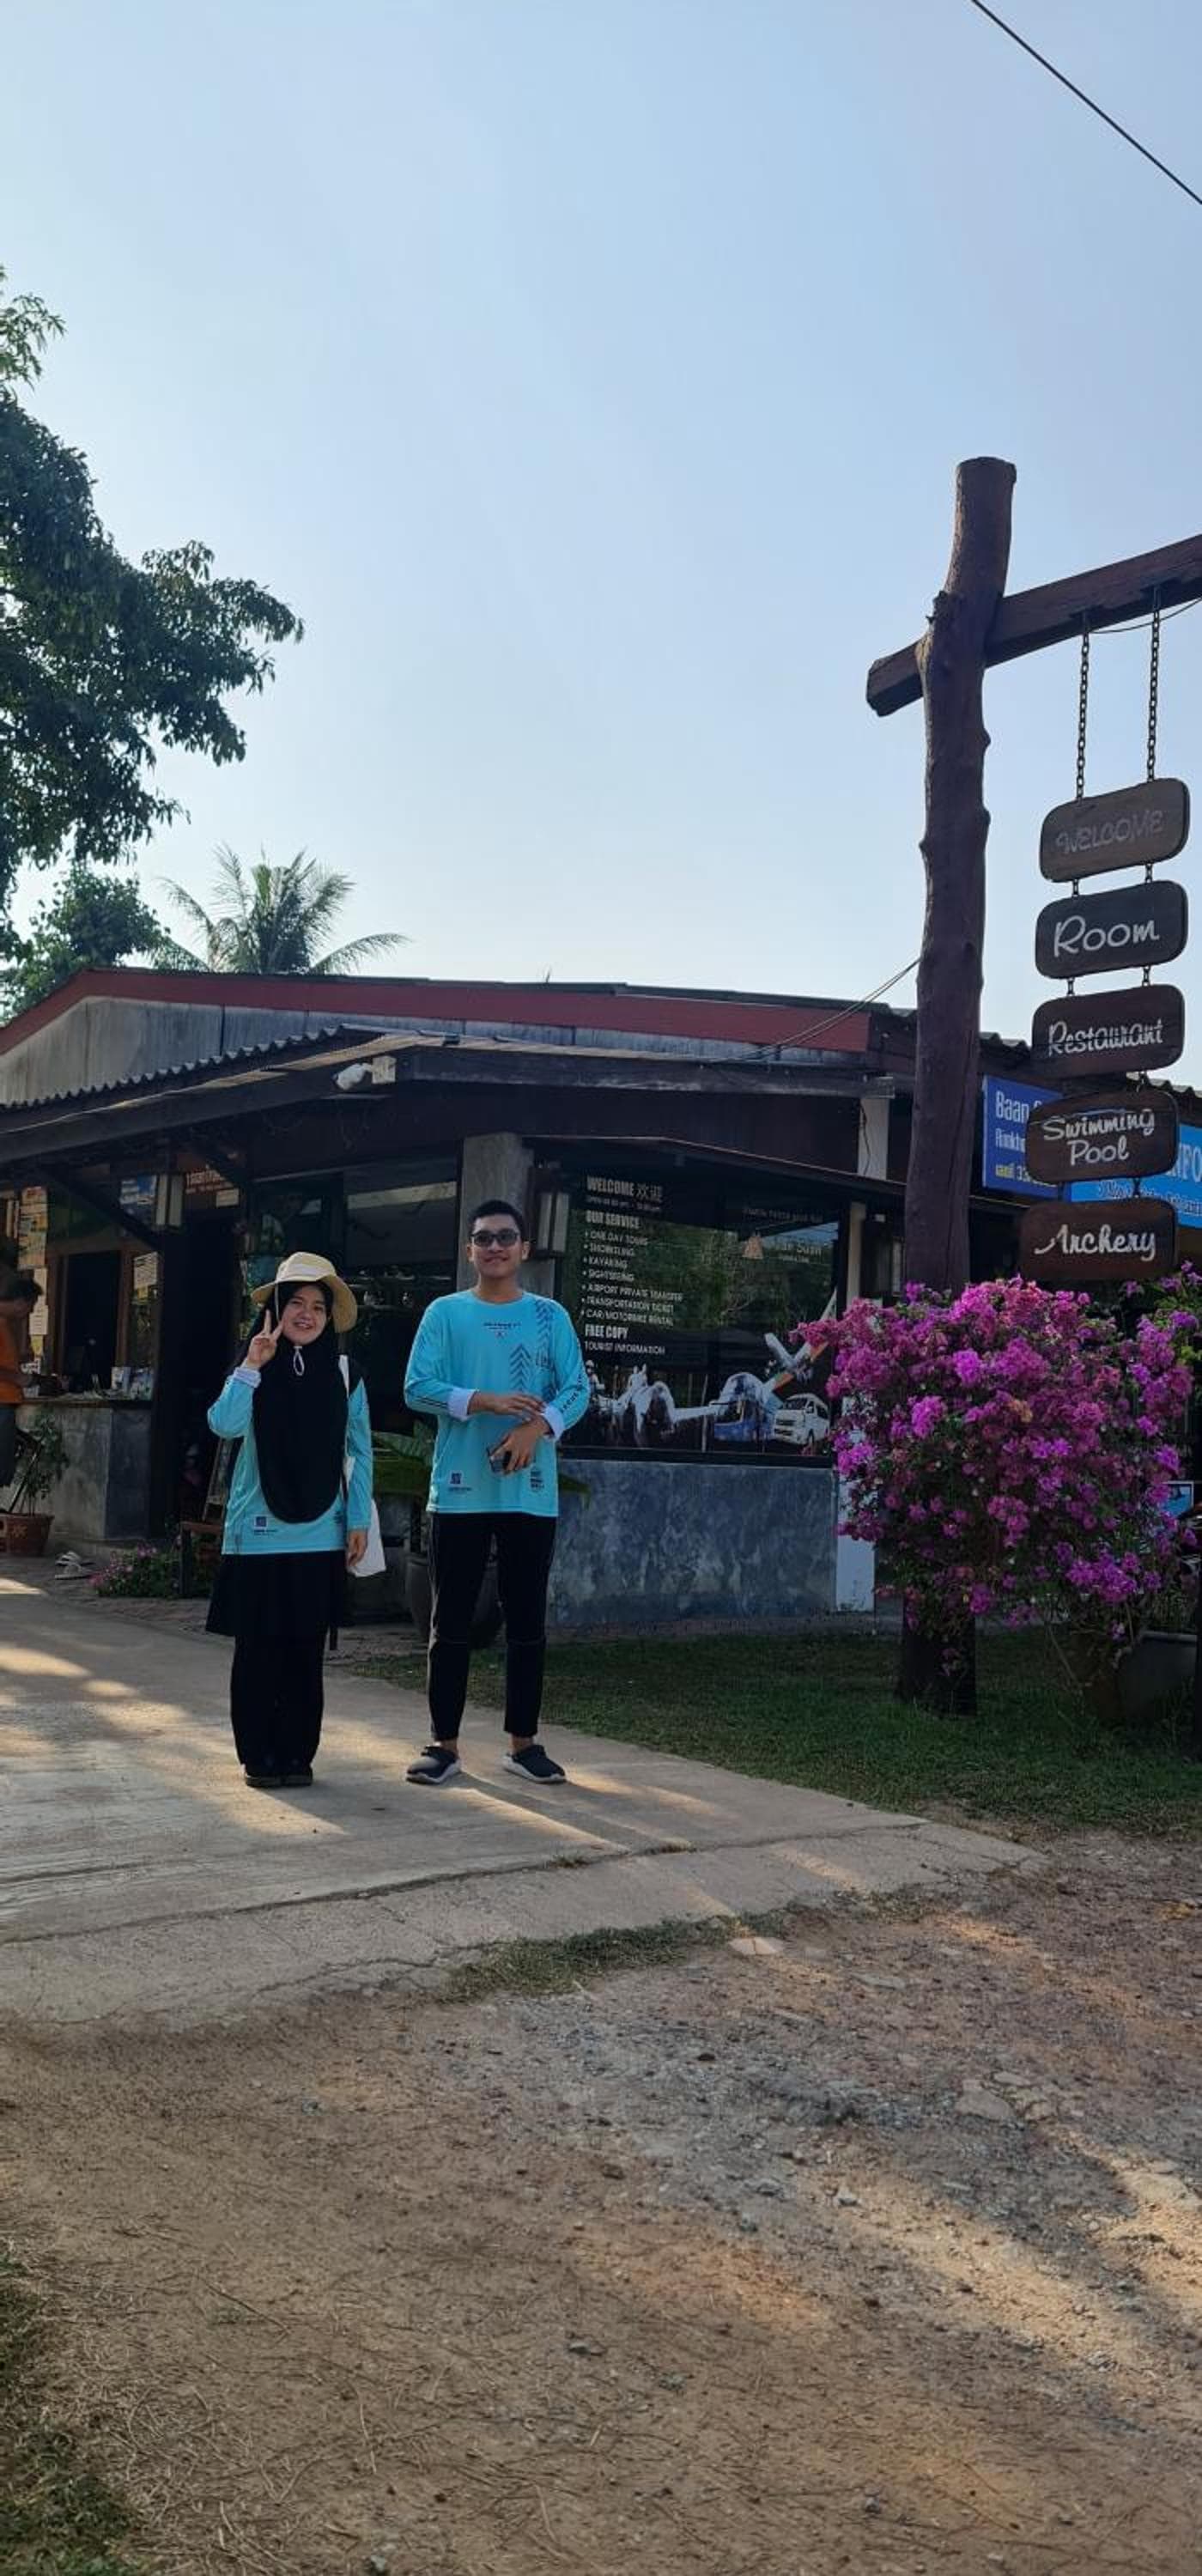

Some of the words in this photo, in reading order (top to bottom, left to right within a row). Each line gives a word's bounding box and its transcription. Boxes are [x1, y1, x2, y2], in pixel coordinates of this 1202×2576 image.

[1055, 809, 1164, 855] WELCOME
[1053, 915, 1160, 958] Room
[1047, 1018, 1164, 1057] Restaurant
[995, 1091, 1029, 1124] Baan
[1041, 1109, 1156, 1141] Swimming
[1066, 1138, 1130, 1167] Pool
[586, 1175, 634, 1196] WELCOME
[586, 1210, 604, 1224] OUR
[605, 1212, 640, 1229] SERVICE
[1034, 1224, 1156, 1261] Archery
[588, 1255, 628, 1269] KAYAKING
[588, 1284, 618, 1294] AIRPORT
[586, 1296, 650, 1310] TRANSPORTATION
[585, 1323, 604, 1338] FREE
[605, 1325, 629, 1340] COPY
[585, 1341, 614, 1352] TOURIST
[614, 1343, 665, 1356] INFORMATION
